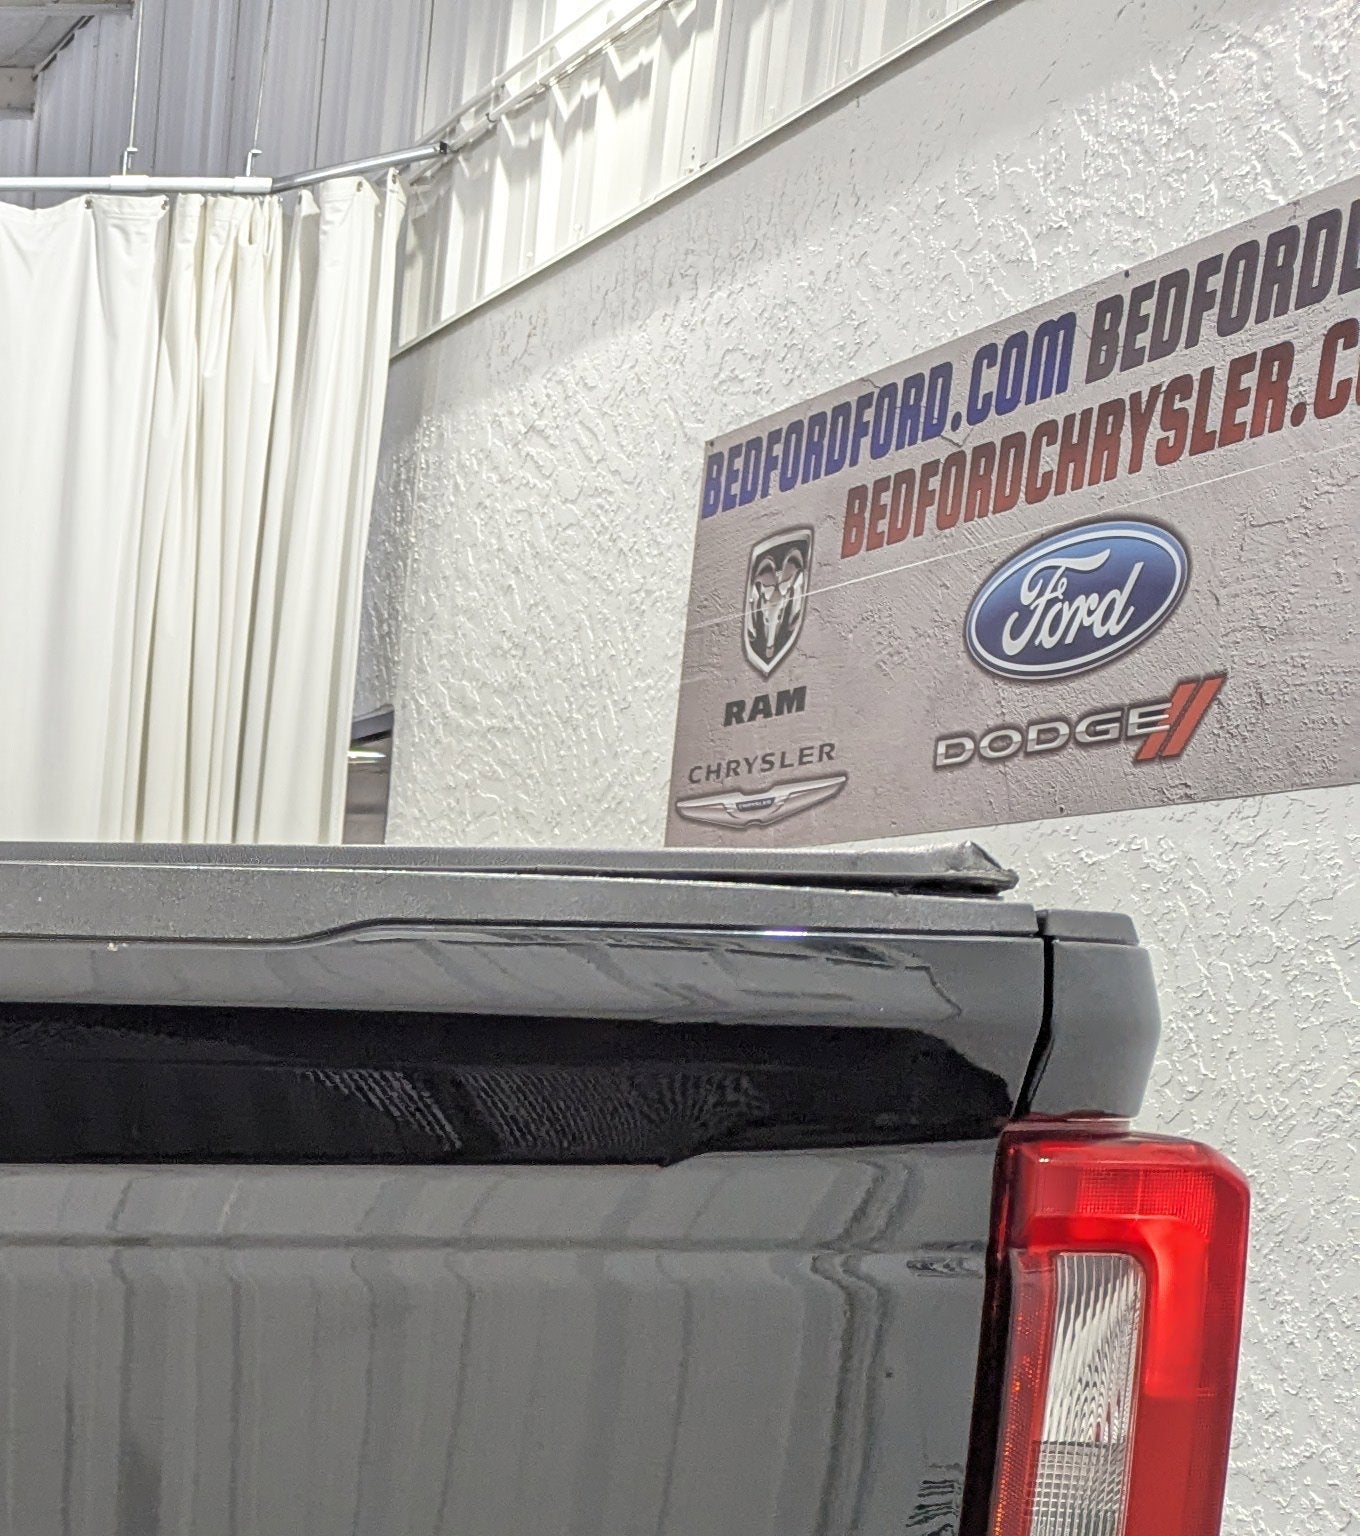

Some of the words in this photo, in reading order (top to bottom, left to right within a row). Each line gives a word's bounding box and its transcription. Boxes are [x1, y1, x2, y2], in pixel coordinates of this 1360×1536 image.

[701, 311, 1077, 519] BEDFORDFORD.COM
[841, 317, 1360, 559] BEDFORDCHRYSLER.C
[1002, 548, 1146, 658] Ford
[723, 685, 807, 727] RAM
[935, 702, 1173, 767] DODGE
[688, 742, 837, 784] CHRYSLER
